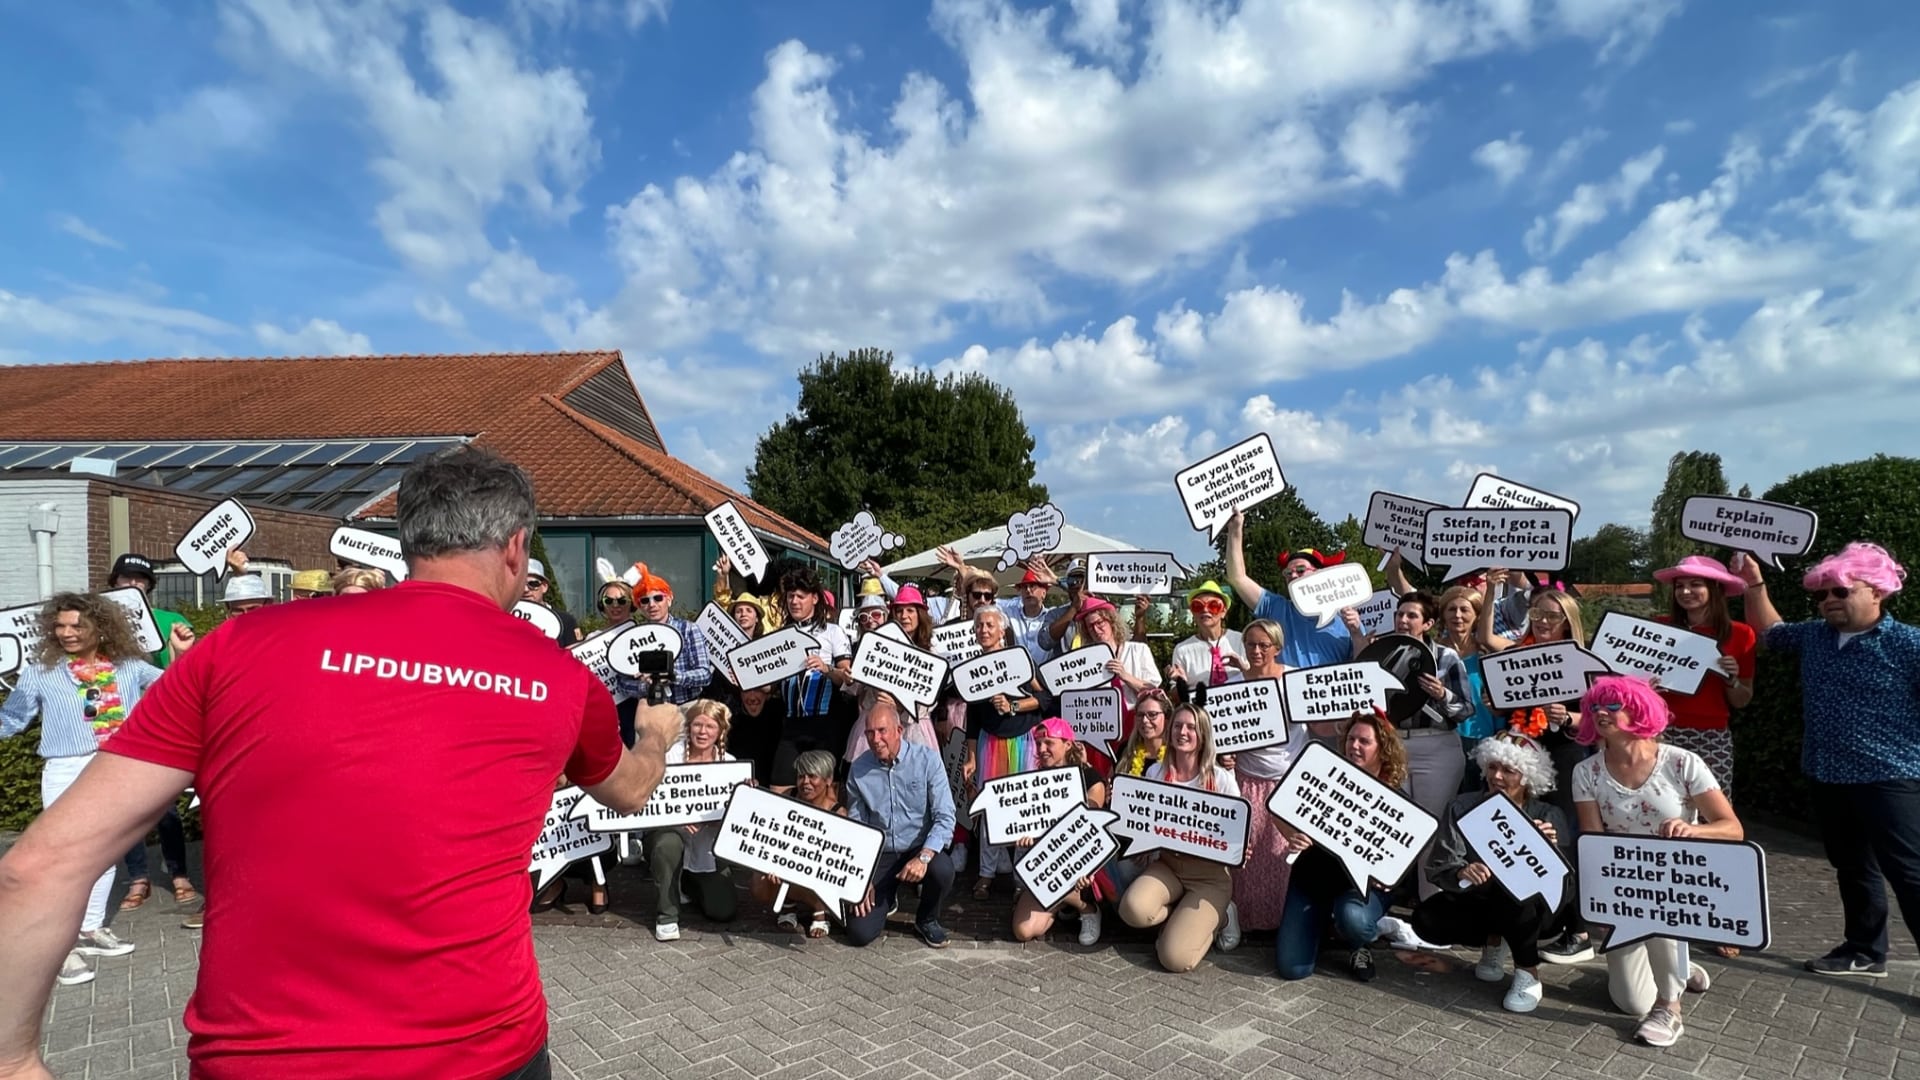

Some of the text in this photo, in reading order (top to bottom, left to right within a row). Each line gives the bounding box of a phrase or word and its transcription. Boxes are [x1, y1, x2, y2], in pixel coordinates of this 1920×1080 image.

[1187, 446, 1264, 487] Can you please
[1204, 463, 1255, 492] check this
[1194, 467, 1274, 510] marketing copy
[1202, 475, 1274, 519] by tomorrow?
[1383, 499, 1425, 517] Thanks
[1716, 506, 1774, 526] Explain
[190, 513, 233, 552] Steentje
[725, 514, 756, 556] Brekz PD
[1374, 522, 1390, 532] we
[1443, 516, 1550, 532] Stefan, I got a
[1689, 520, 1799, 545] nutrigenomics
[202, 527, 239, 559] helpen
[712, 513, 751, 571] Easy to Love
[1384, 533, 1408, 547] how
[1431, 530, 1556, 545] stupid technical
[1430, 546, 1559, 562] question for you
[1095, 561, 1167, 573] A vet should
[1095, 573, 1128, 584] know
[1130, 573, 1152, 585] this
[1297, 573, 1361, 596] Thank you
[1315, 585, 1358, 605] Stefan!
[630, 631, 657, 650] And
[707, 626, 728, 649] maar
[936, 628, 966, 642] What
[946, 641, 964, 651] the
[1631, 625, 1676, 648] Use a
[737, 639, 797, 668] Spannende
[873, 641, 934, 672] So... What
[1059, 657, 1086, 672] How
[1496, 653, 1563, 672] Thanks
[320, 648, 548, 702] LIPDUBWORLD
[754, 656, 788, 675] broek
[865, 650, 933, 685] is your first
[969, 660, 1007, 680] NO, in
[1054, 662, 1103, 687] are you?
[861, 666, 932, 697] question???
[969, 670, 1020, 694] case of...
[1305, 670, 1364, 686] Explain
[1505, 670, 1563, 687] to you
[1066, 696, 1112, 708] ...the KTN
[1253, 686, 1268, 696] to
[1302, 682, 1371, 700] the Hill's
[1503, 685, 1579, 702] Stefan...
[1076, 709, 1102, 720] is our
[1209, 699, 1268, 719] vet with
[1306, 698, 1374, 716] alphabet
[1070, 722, 1114, 735] oly bible
[1231, 717, 1261, 730] new
[1216, 730, 1274, 747] uestions
[992, 772, 1072, 795] What do we
[1327, 766, 1404, 823] I have just
[665, 802, 681, 814] be
[686, 800, 720, 815] your
[998, 787, 1069, 808] feed a dog
[1122, 789, 1237, 820] ...we talk about
[1019, 803, 1051, 818] with
[1128, 803, 1225, 836] vet practices,
[1300, 771, 1414, 849] one more small
[787, 809, 827, 835] Great,
[1296, 786, 1394, 858] thing to add...
[749, 811, 854, 860] he is the expert,
[1024, 814, 1089, 872] Can the vet
[1126, 819, 1228, 852] not vet clinics
[1295, 806, 1312, 818] if
[1353, 844, 1384, 862] ok?
[1490, 808, 1548, 878] Yes, you
[549, 834, 602, 860] parents
[731, 823, 864, 880] we know each other,
[1032, 823, 1099, 887] recommend
[1487, 839, 1515, 868] can
[1613, 845, 1707, 867] Bring the
[738, 839, 847, 888] he is soooo kind
[1047, 838, 1104, 893] GI Biome?
[1601, 866, 1729, 892] sizzler back,
[1614, 886, 1716, 911] complete,
[1590, 897, 1750, 936] in the right bag
